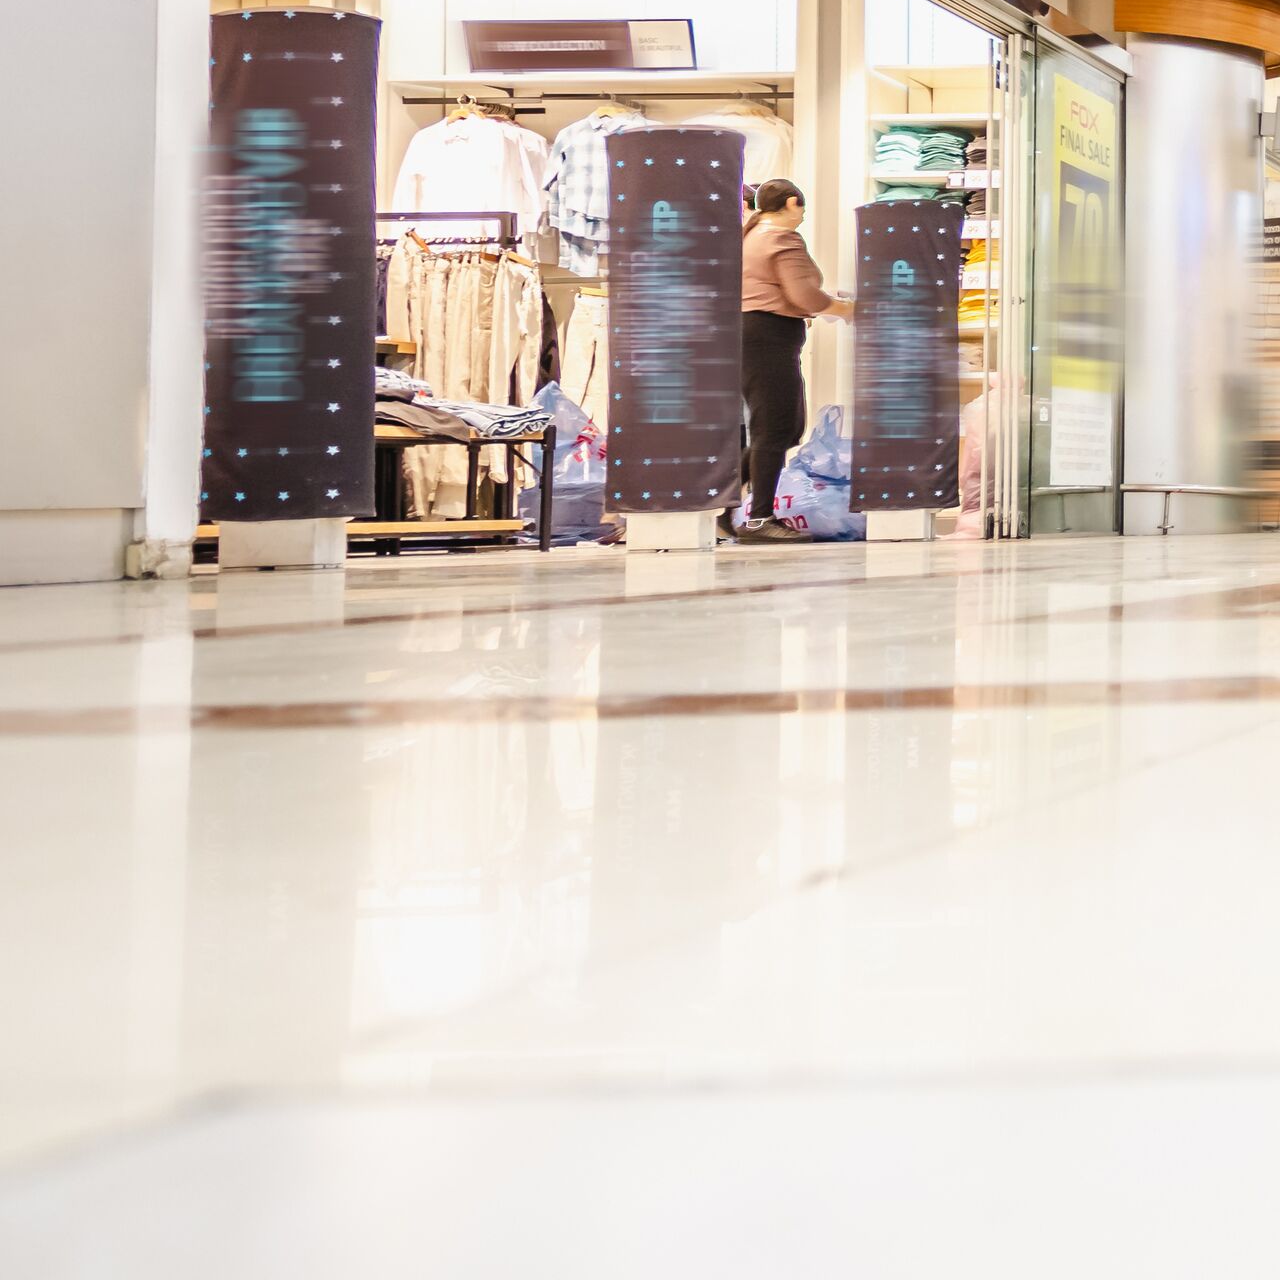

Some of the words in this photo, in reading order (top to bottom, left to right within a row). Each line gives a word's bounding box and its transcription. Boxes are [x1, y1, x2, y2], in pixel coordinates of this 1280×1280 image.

[1071, 100, 1099, 134] FOX
[1060, 125, 1086, 160] FINAL
[1088, 139, 1110, 167] SALE
